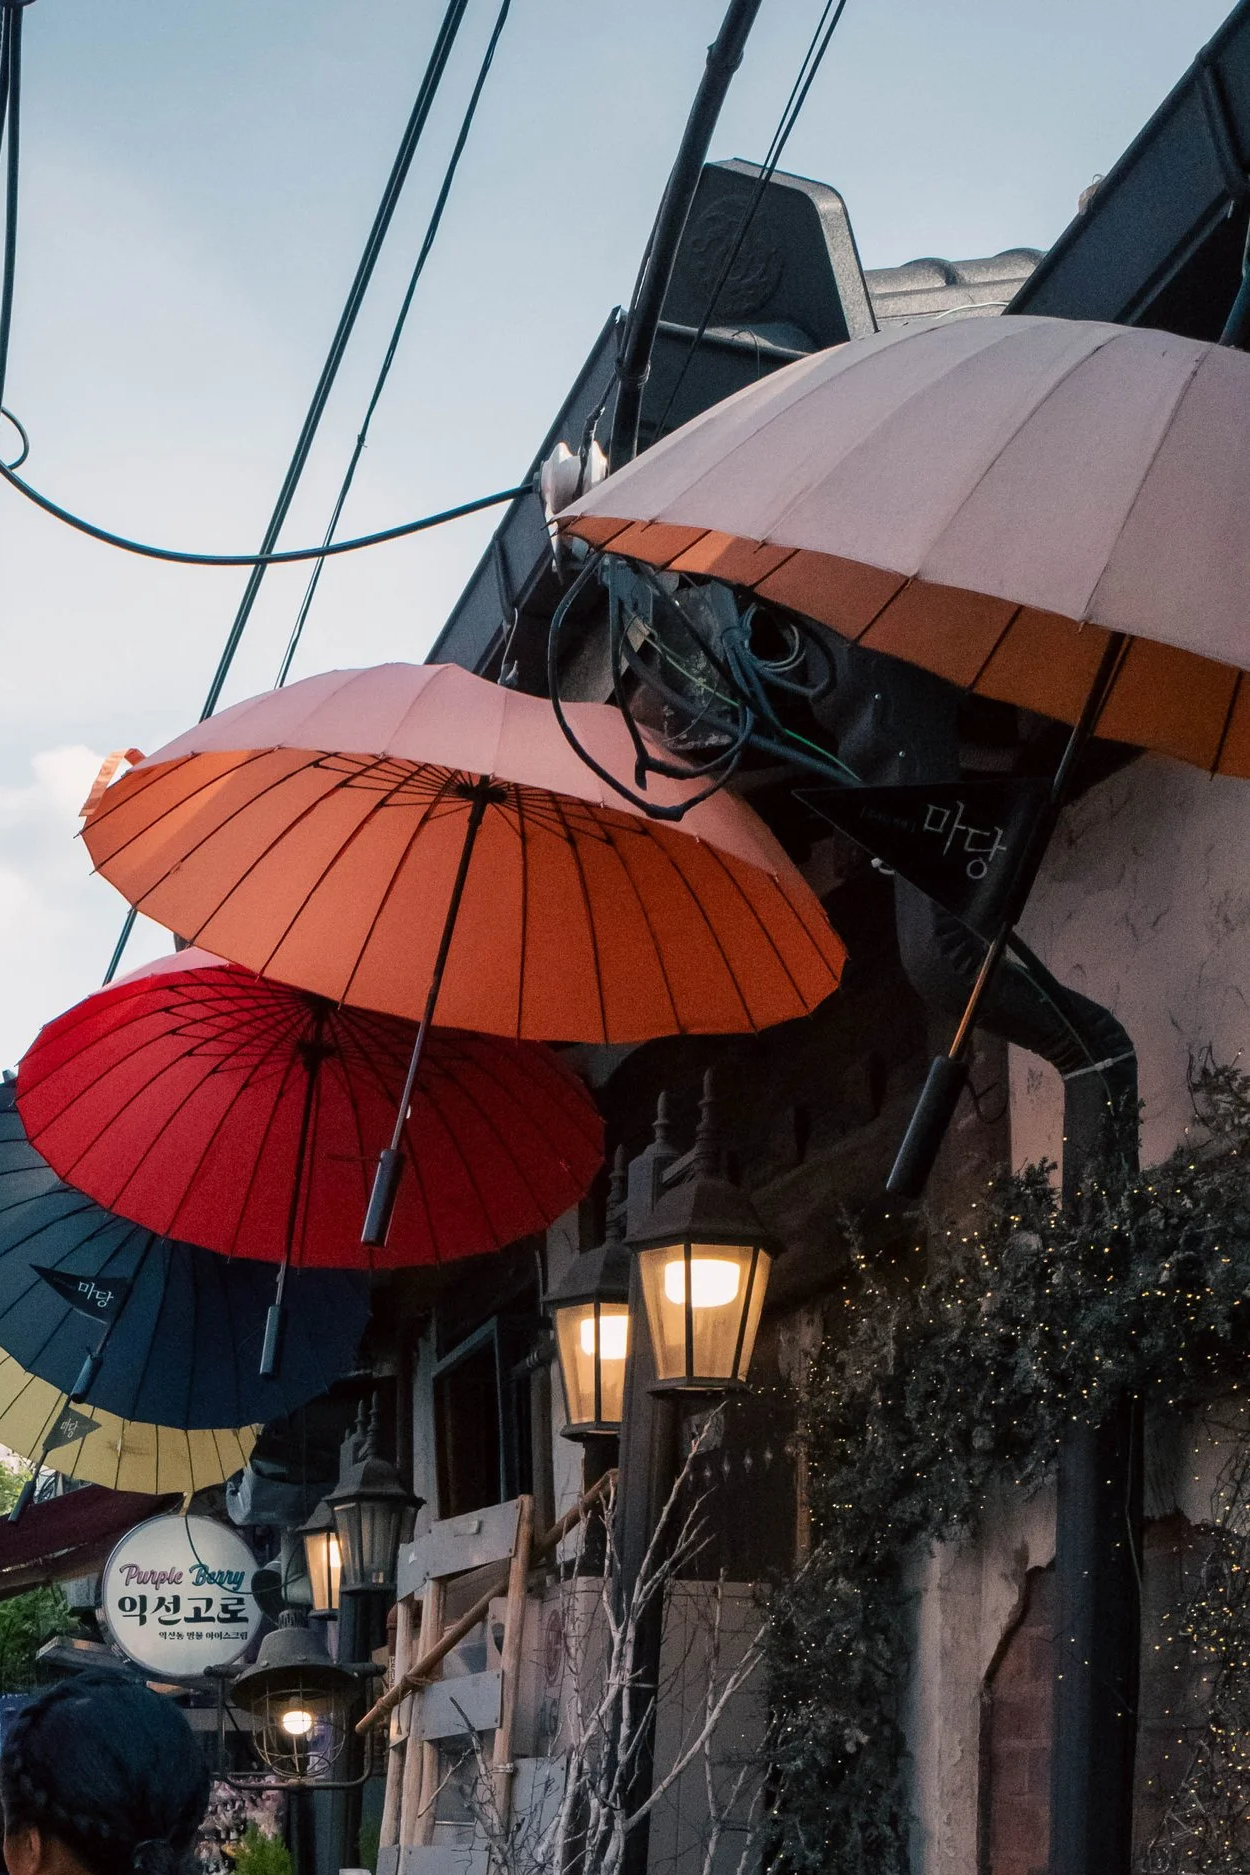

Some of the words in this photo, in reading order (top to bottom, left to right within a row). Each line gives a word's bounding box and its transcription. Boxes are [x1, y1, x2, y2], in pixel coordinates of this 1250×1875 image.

[922, 800, 1007, 879] 마당
[78, 1281, 114, 1308] 마당
[60, 1417, 79, 1439] 마당
[119, 1563, 183, 1591] Purple
[189, 1563, 245, 1591] Berry
[118, 1594, 249, 1626] 익선고로
[205, 1631, 248, 1641] 아이스크림
